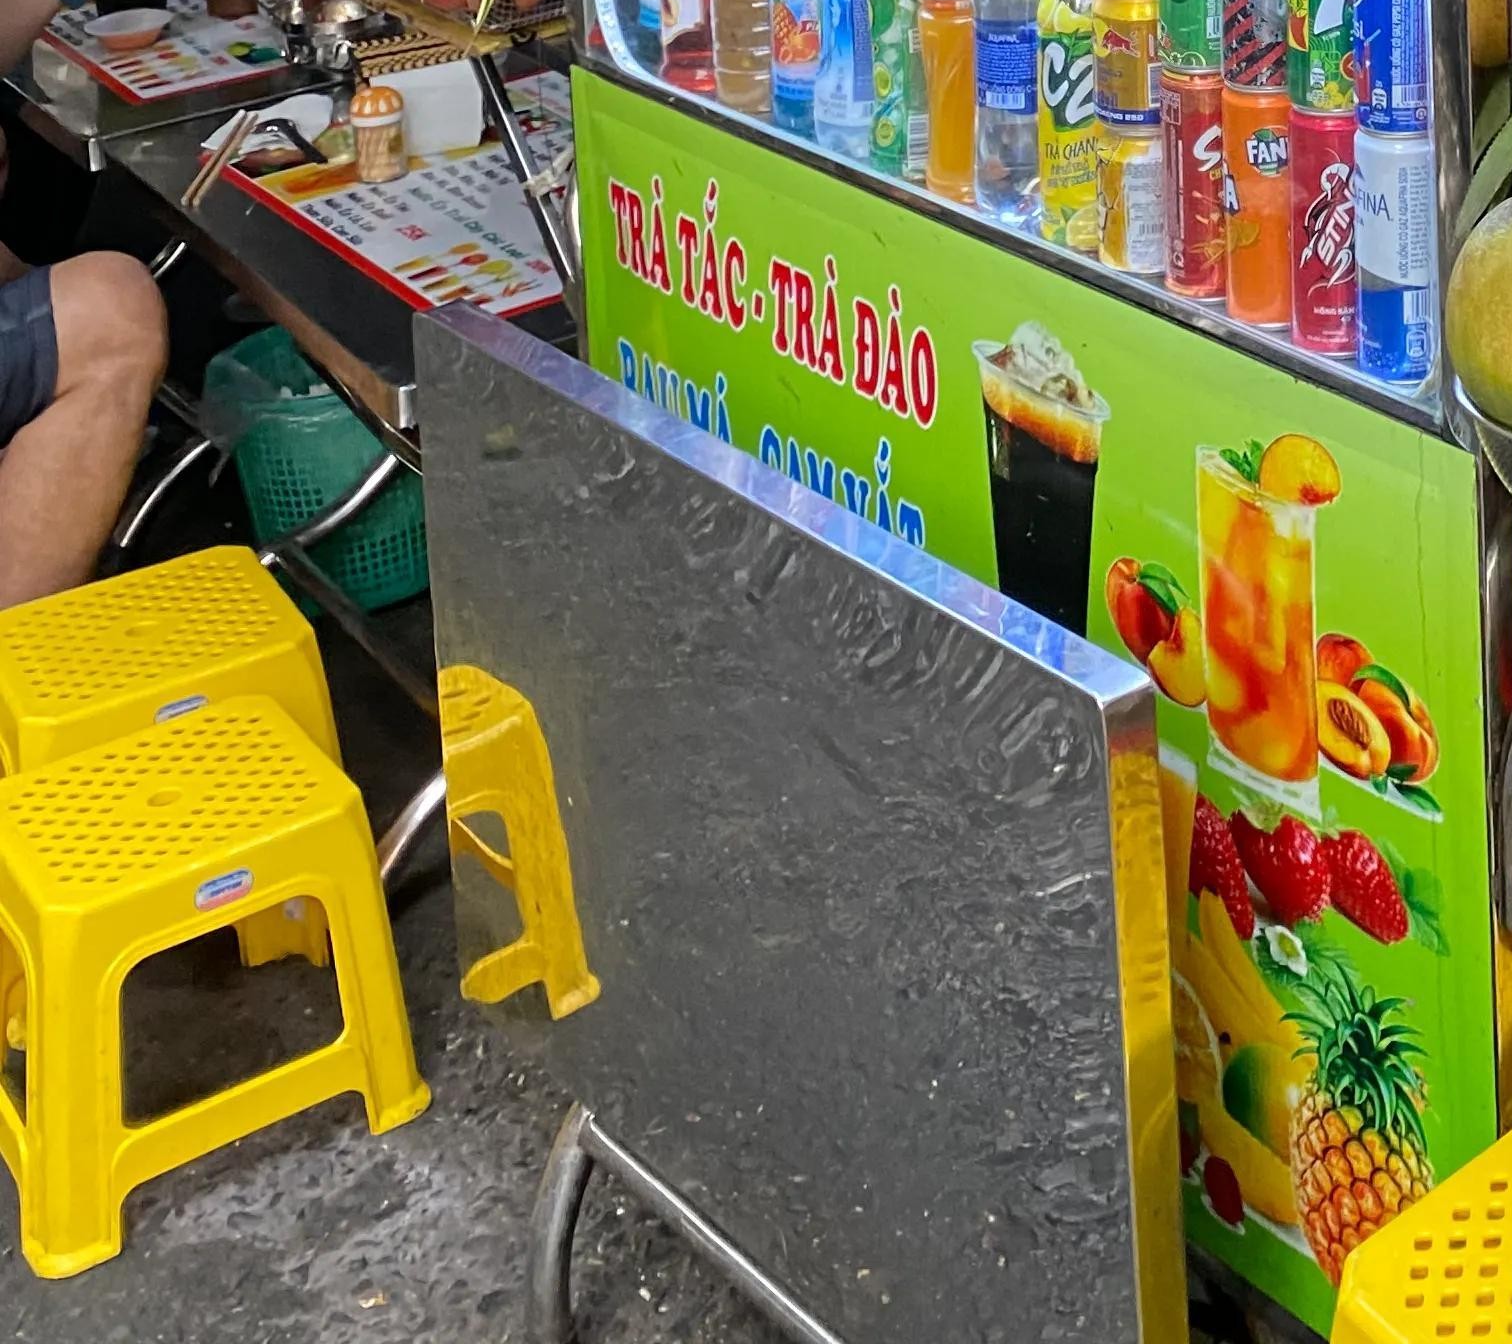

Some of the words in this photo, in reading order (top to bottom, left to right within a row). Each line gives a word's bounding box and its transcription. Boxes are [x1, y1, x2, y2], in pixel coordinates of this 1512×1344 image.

[609, 175, 673, 296] TRÀ
[676, 178, 747, 332] TẮC
[769, 254, 846, 386] TRÀ
[853, 283, 939, 430] ĐÀO
